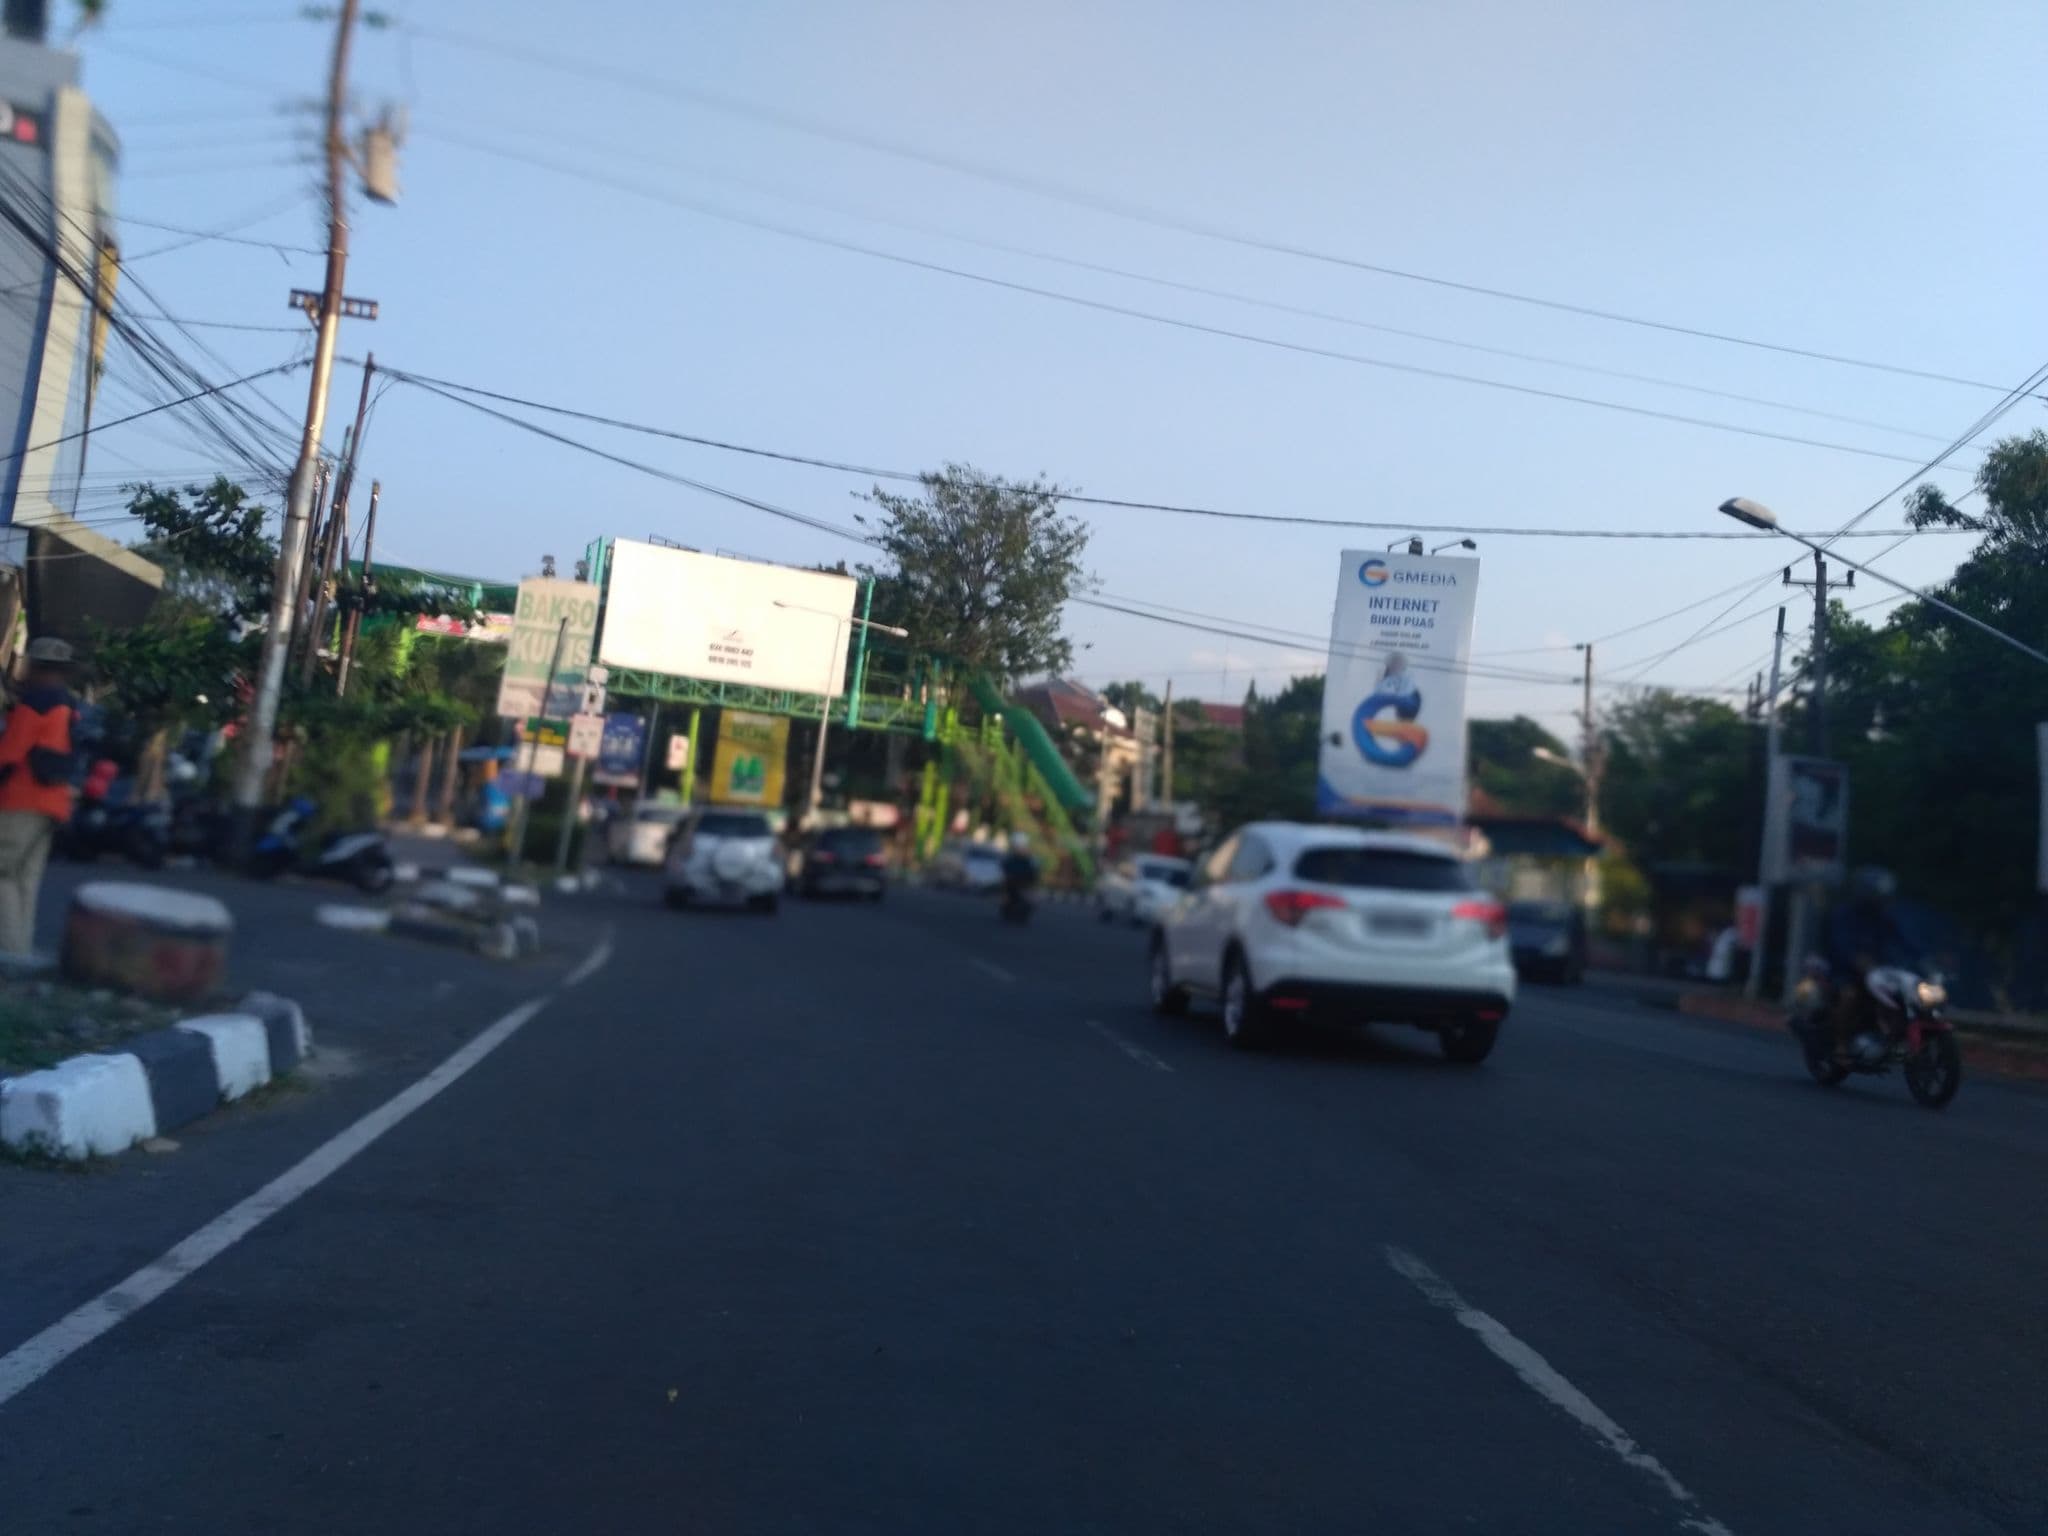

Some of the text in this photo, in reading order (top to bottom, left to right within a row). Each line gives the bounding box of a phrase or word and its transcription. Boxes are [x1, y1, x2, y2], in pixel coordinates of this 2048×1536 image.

[1393, 571, 1457, 587] GMEDIA
[518, 591, 596, 628] BAKSO
[1369, 596, 1440, 613] INTERNET
[1370, 614, 1435, 629] BIKIN PUAS
[509, 628, 588, 667] KUIS
